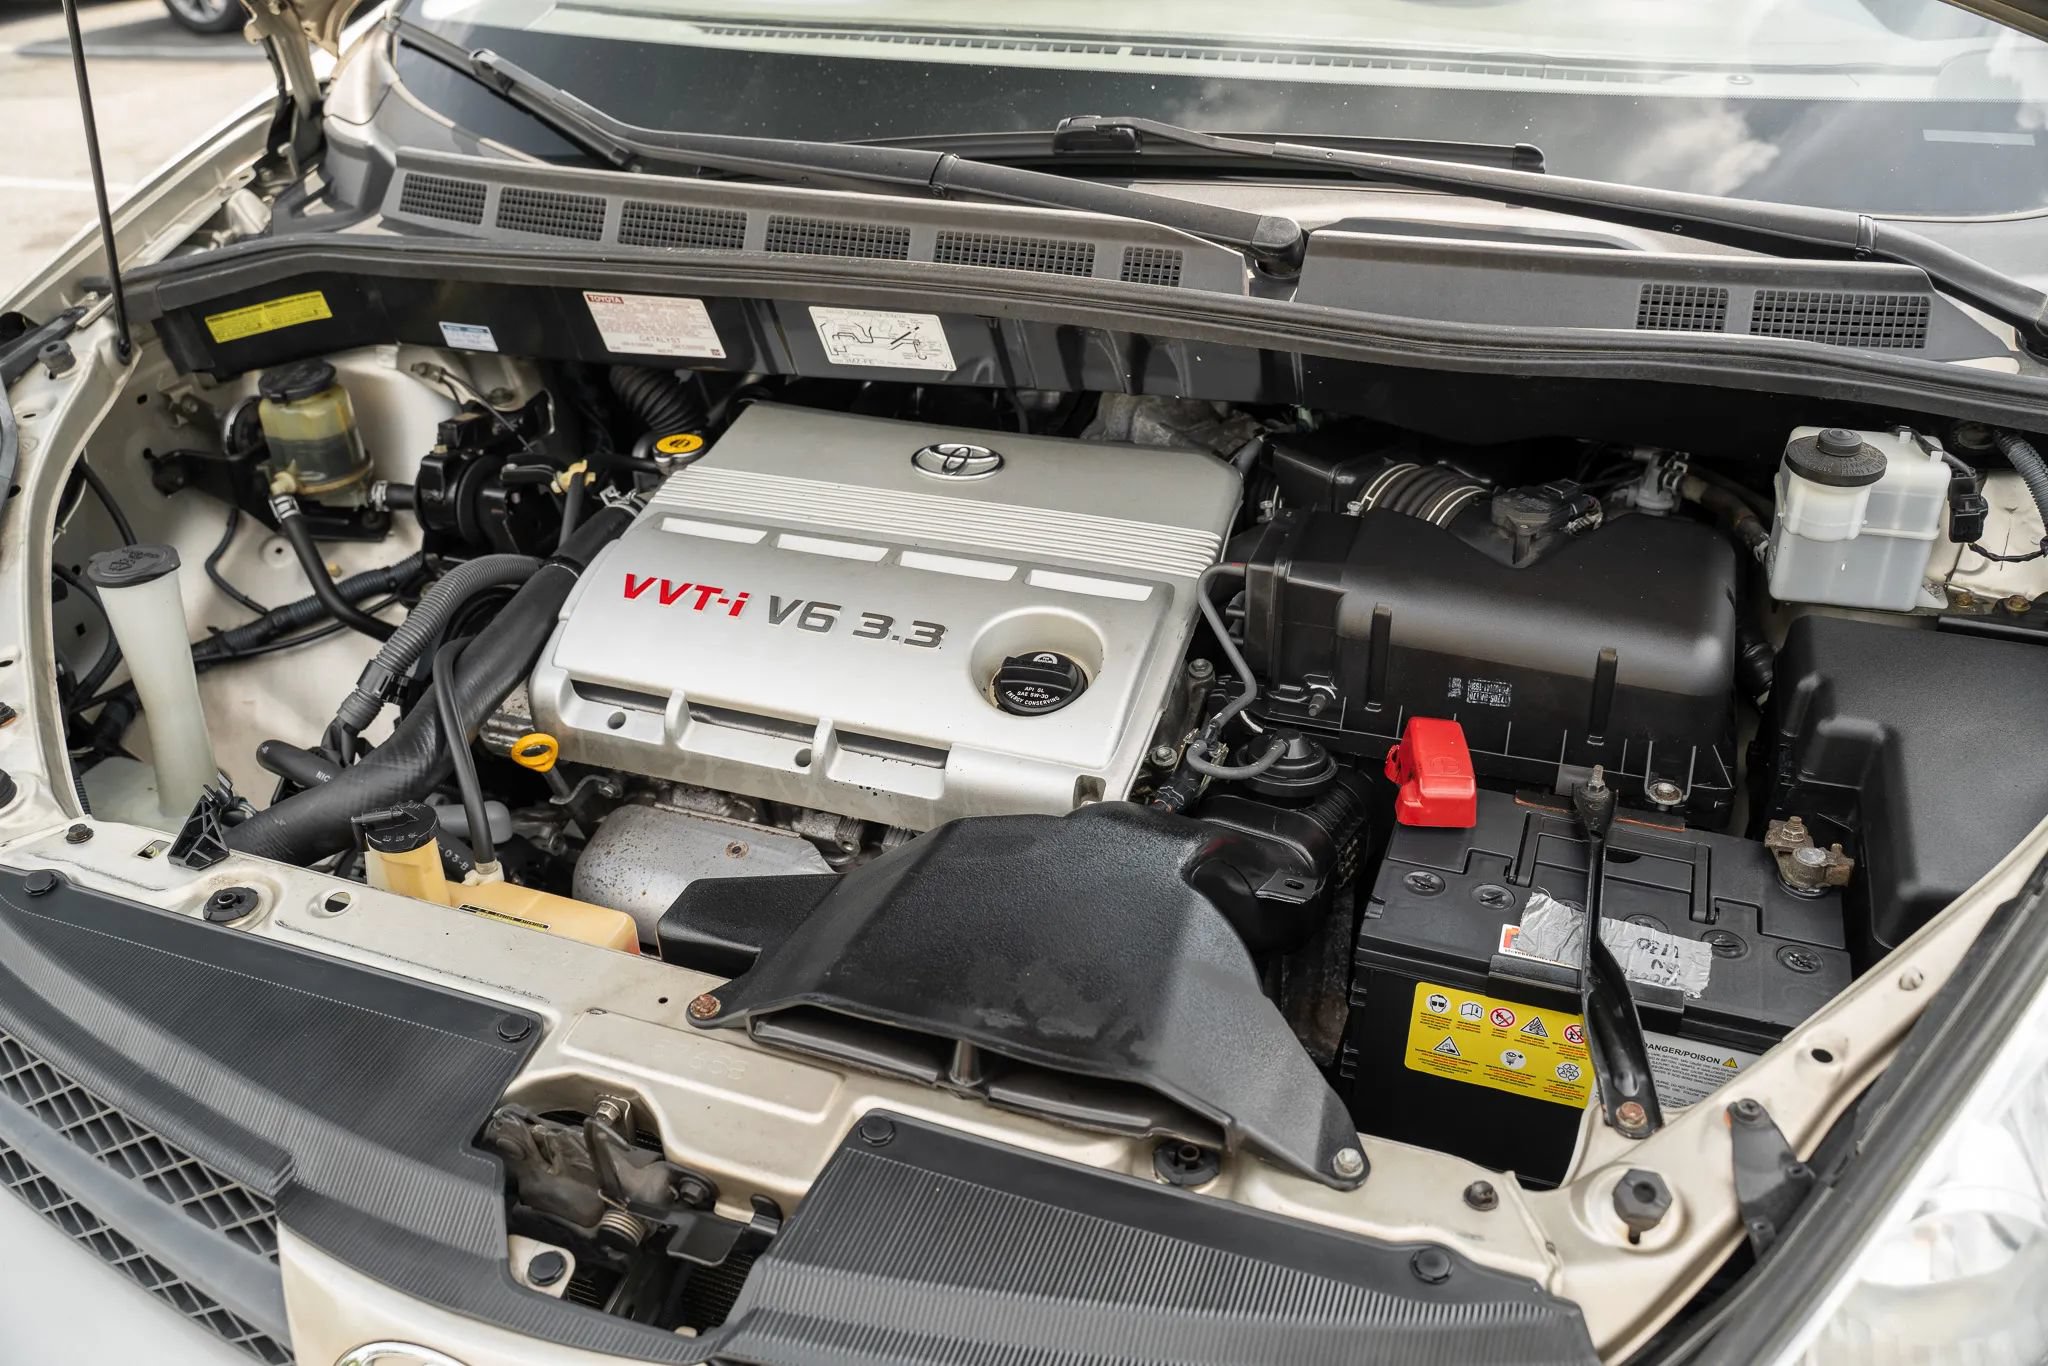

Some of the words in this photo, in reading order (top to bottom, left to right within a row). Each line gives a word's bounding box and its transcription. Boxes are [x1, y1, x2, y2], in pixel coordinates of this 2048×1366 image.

[589, 295, 622, 304] TOYOTA
[623, 573, 750, 618] VVT-i
[768, 595, 842, 634] V6
[852, 612, 946, 649] 3.3
[1005, 690, 1024, 703] ENERGY
[1024, 695, 1060, 706] CONSERVING
